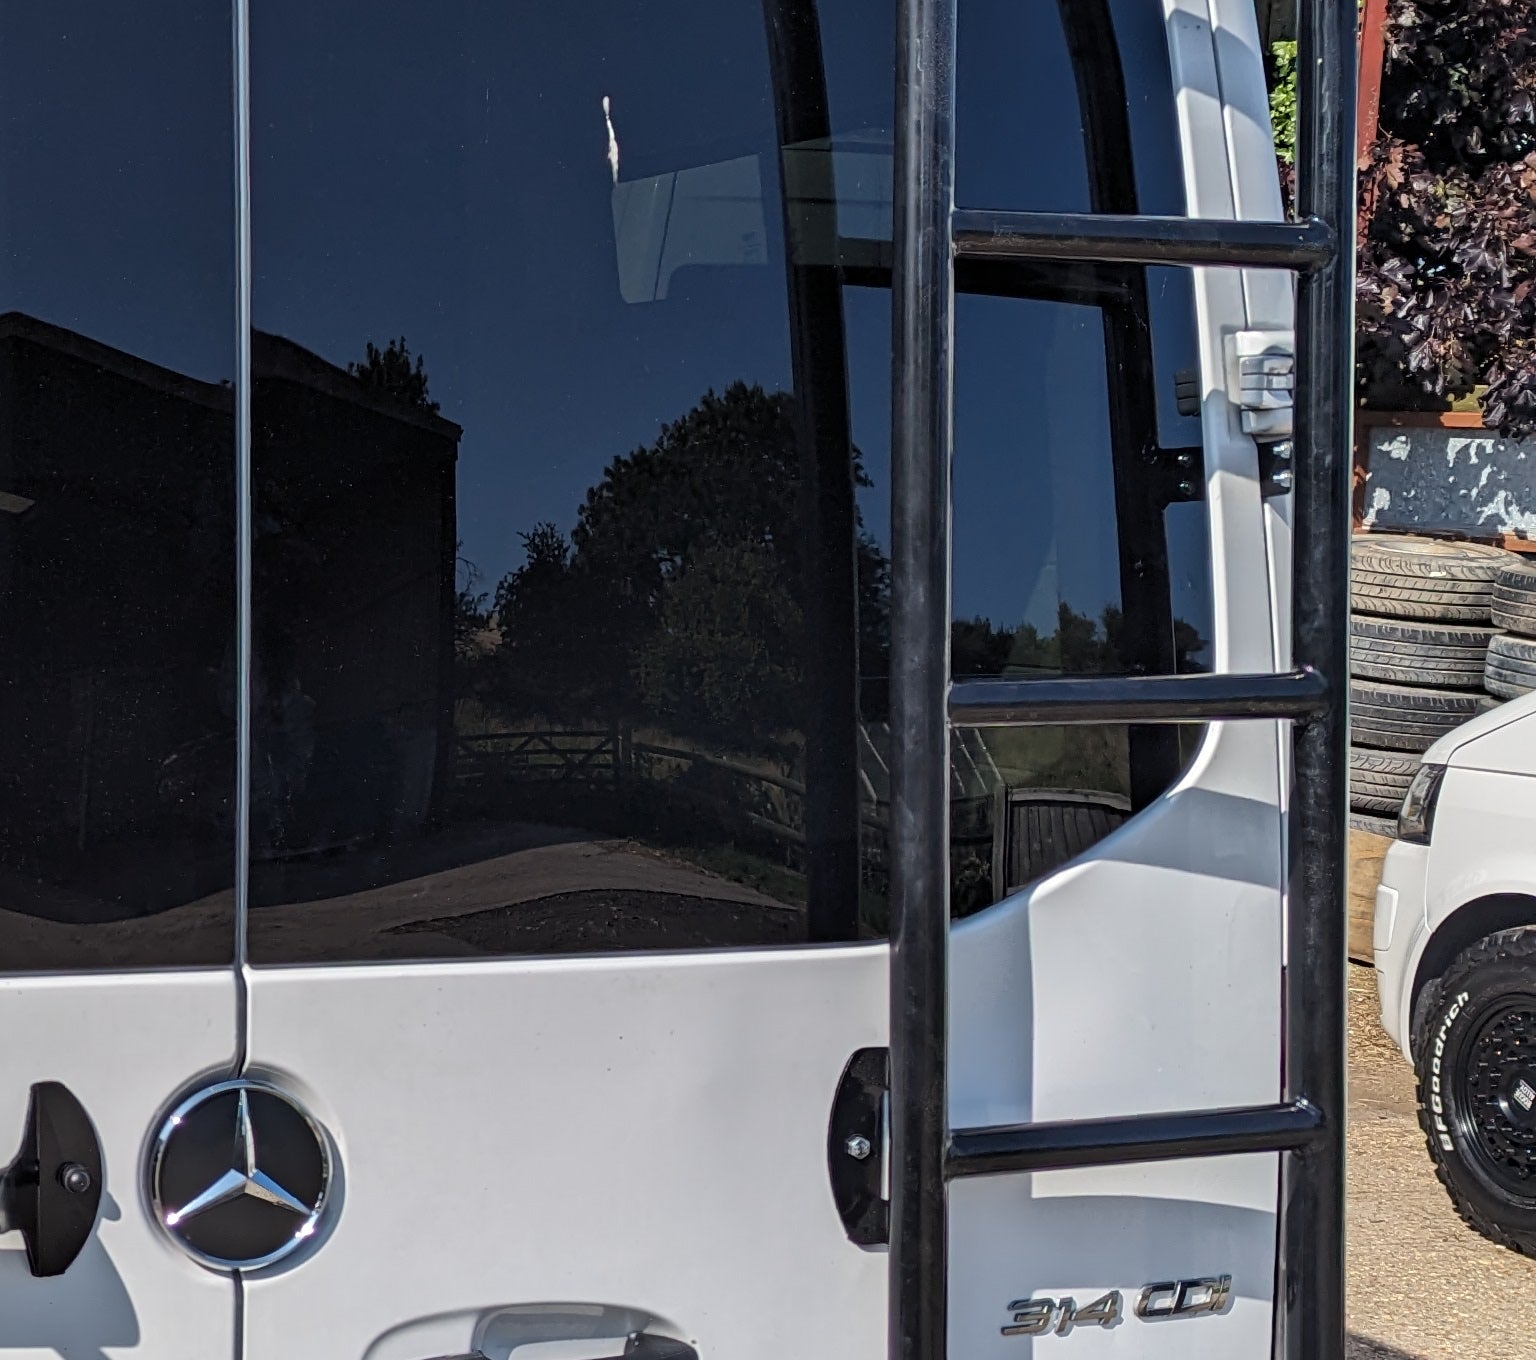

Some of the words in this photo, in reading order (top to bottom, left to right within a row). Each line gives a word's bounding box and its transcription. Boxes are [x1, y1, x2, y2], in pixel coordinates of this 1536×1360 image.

[1431, 991, 1470, 1151] BFGoodrich
[1001, 1289, 1120, 1337] 314
[1137, 1274, 1231, 1319] CDI
